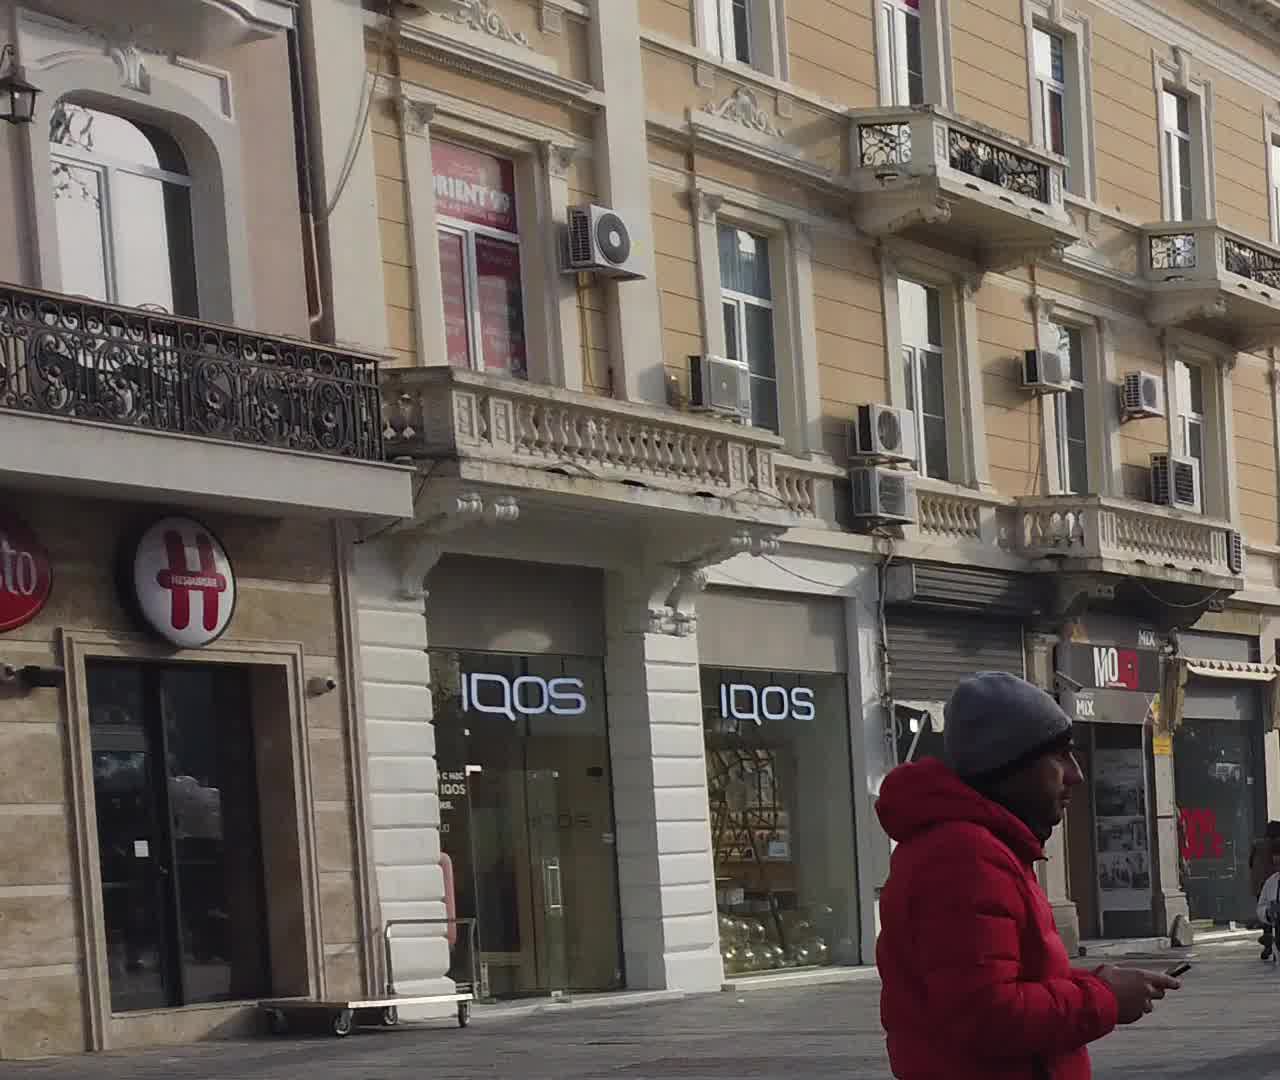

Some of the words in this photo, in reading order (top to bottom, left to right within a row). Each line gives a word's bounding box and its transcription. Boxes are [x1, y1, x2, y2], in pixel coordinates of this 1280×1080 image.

[462, 673, 586, 721] IQOS
[720, 683, 816, 726] IQOS
[1076, 699, 1095, 716] MIX
